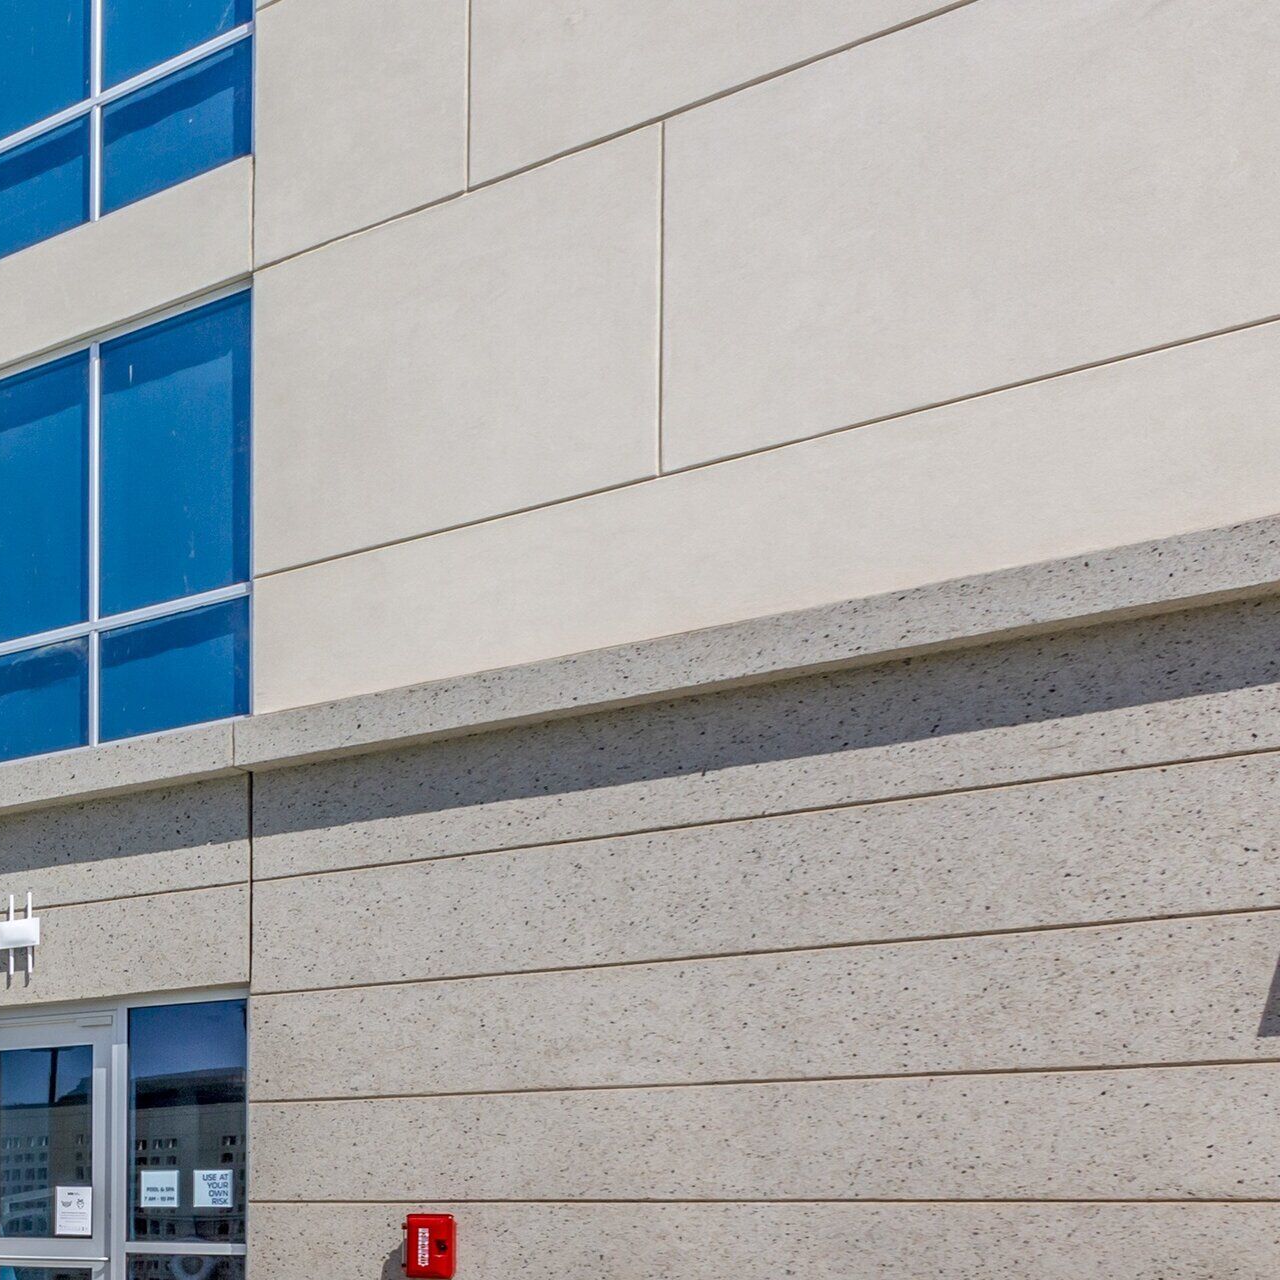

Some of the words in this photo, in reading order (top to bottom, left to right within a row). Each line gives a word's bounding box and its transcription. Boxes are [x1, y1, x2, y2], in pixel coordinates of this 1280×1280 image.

[202, 1173, 217, 1181] USE
[219, 1173, 228, 1181] AT
[208, 1189, 228, 1197] OWN
